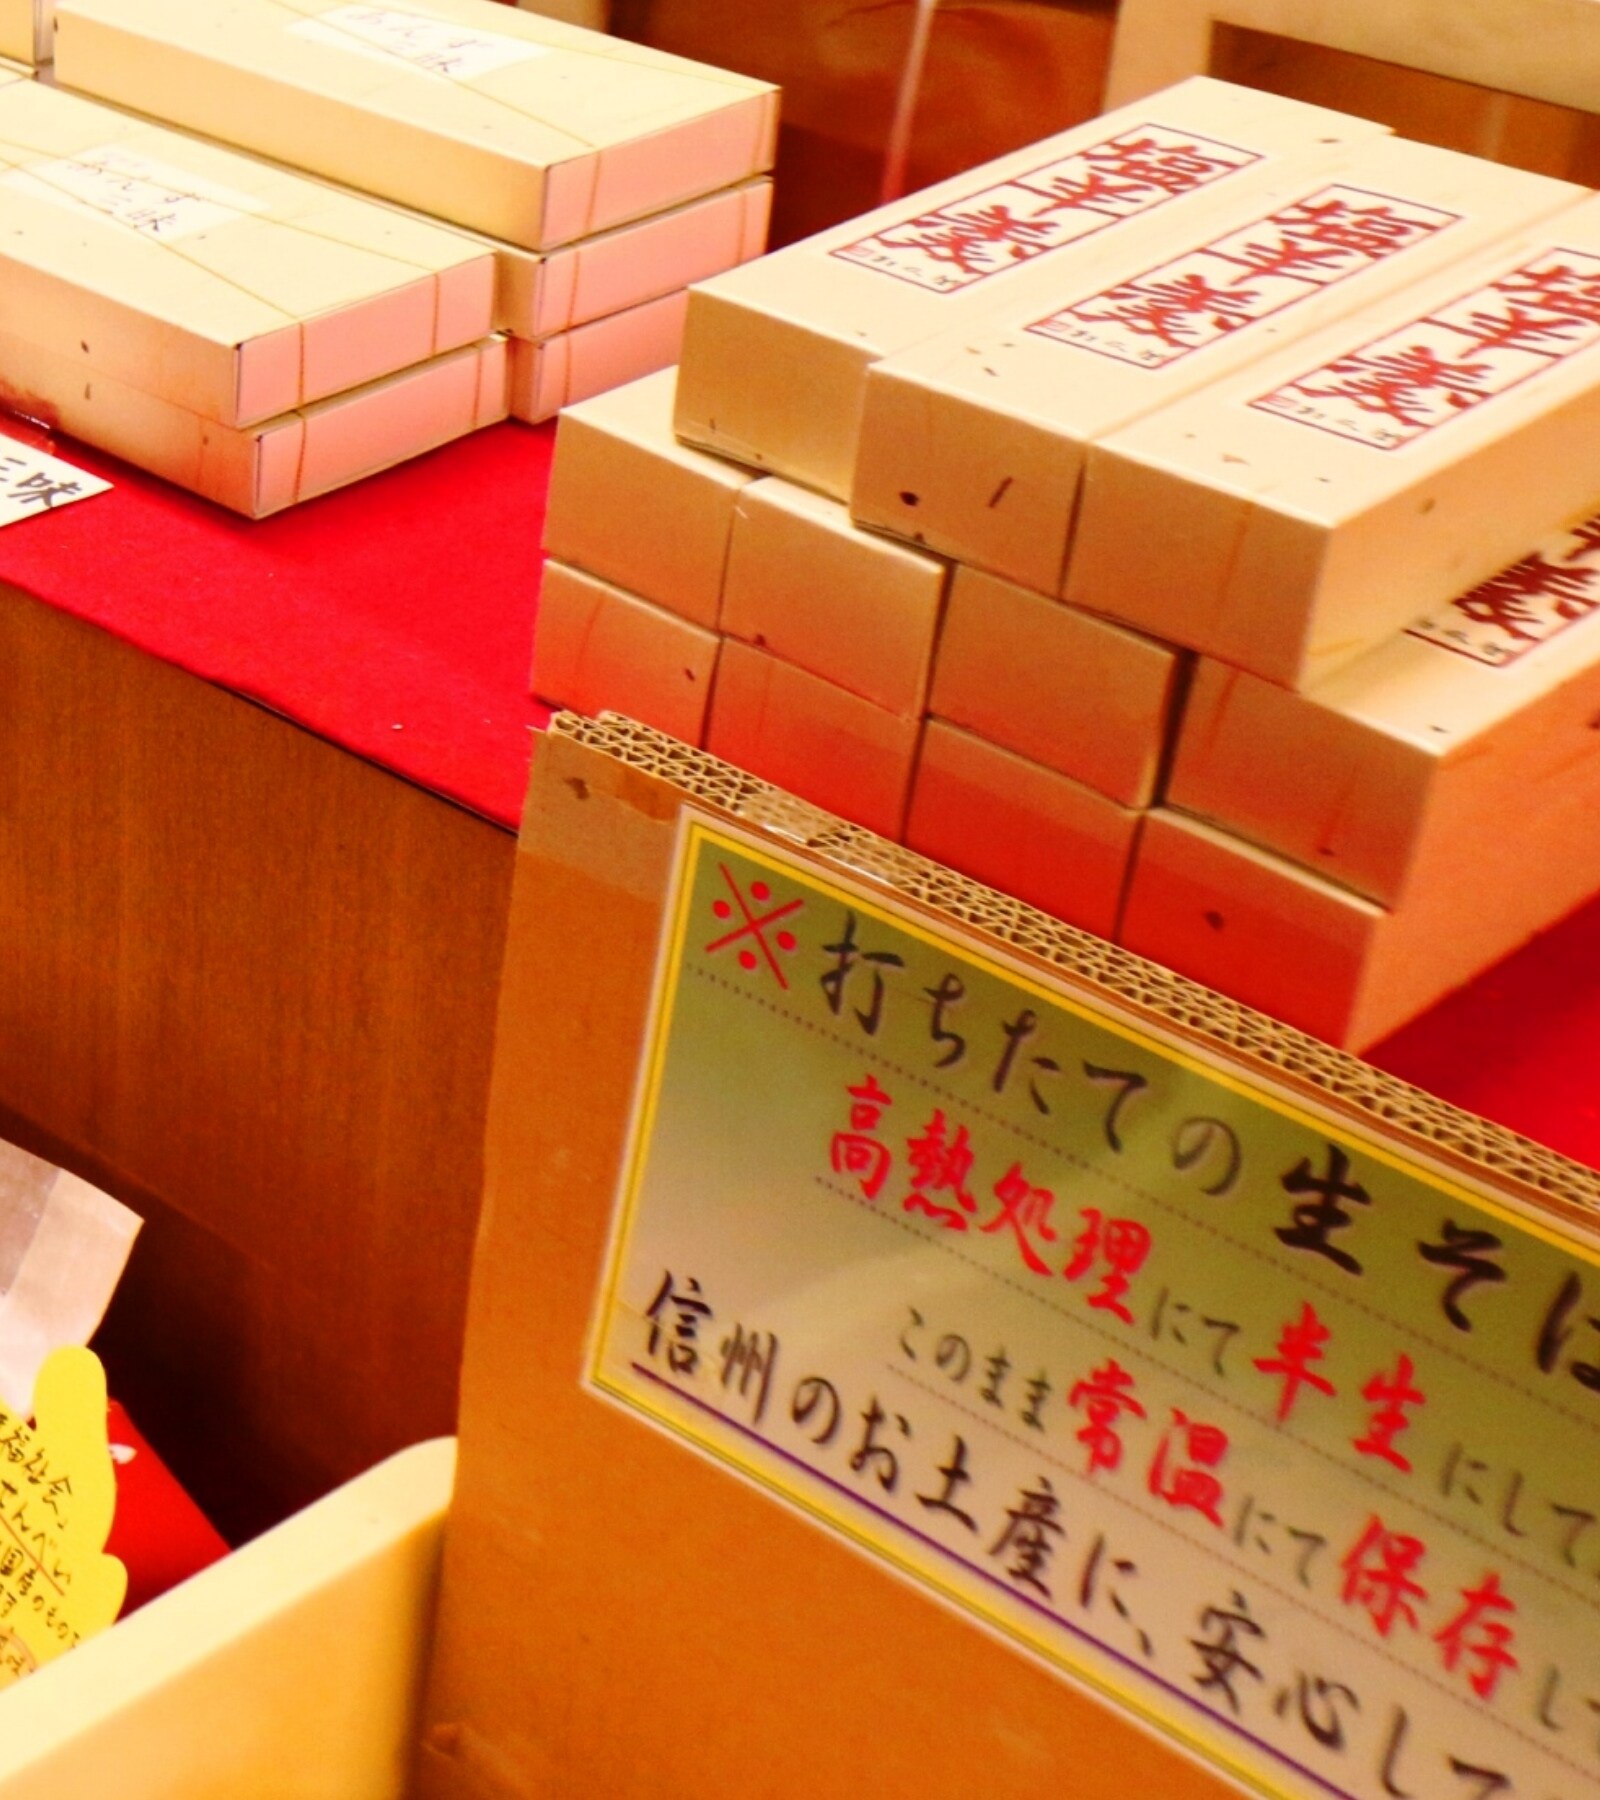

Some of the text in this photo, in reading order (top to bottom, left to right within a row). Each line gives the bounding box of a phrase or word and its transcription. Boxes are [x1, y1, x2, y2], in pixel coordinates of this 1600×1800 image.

[895, 1305, 1600, 1752] このまま常温にて保存し
